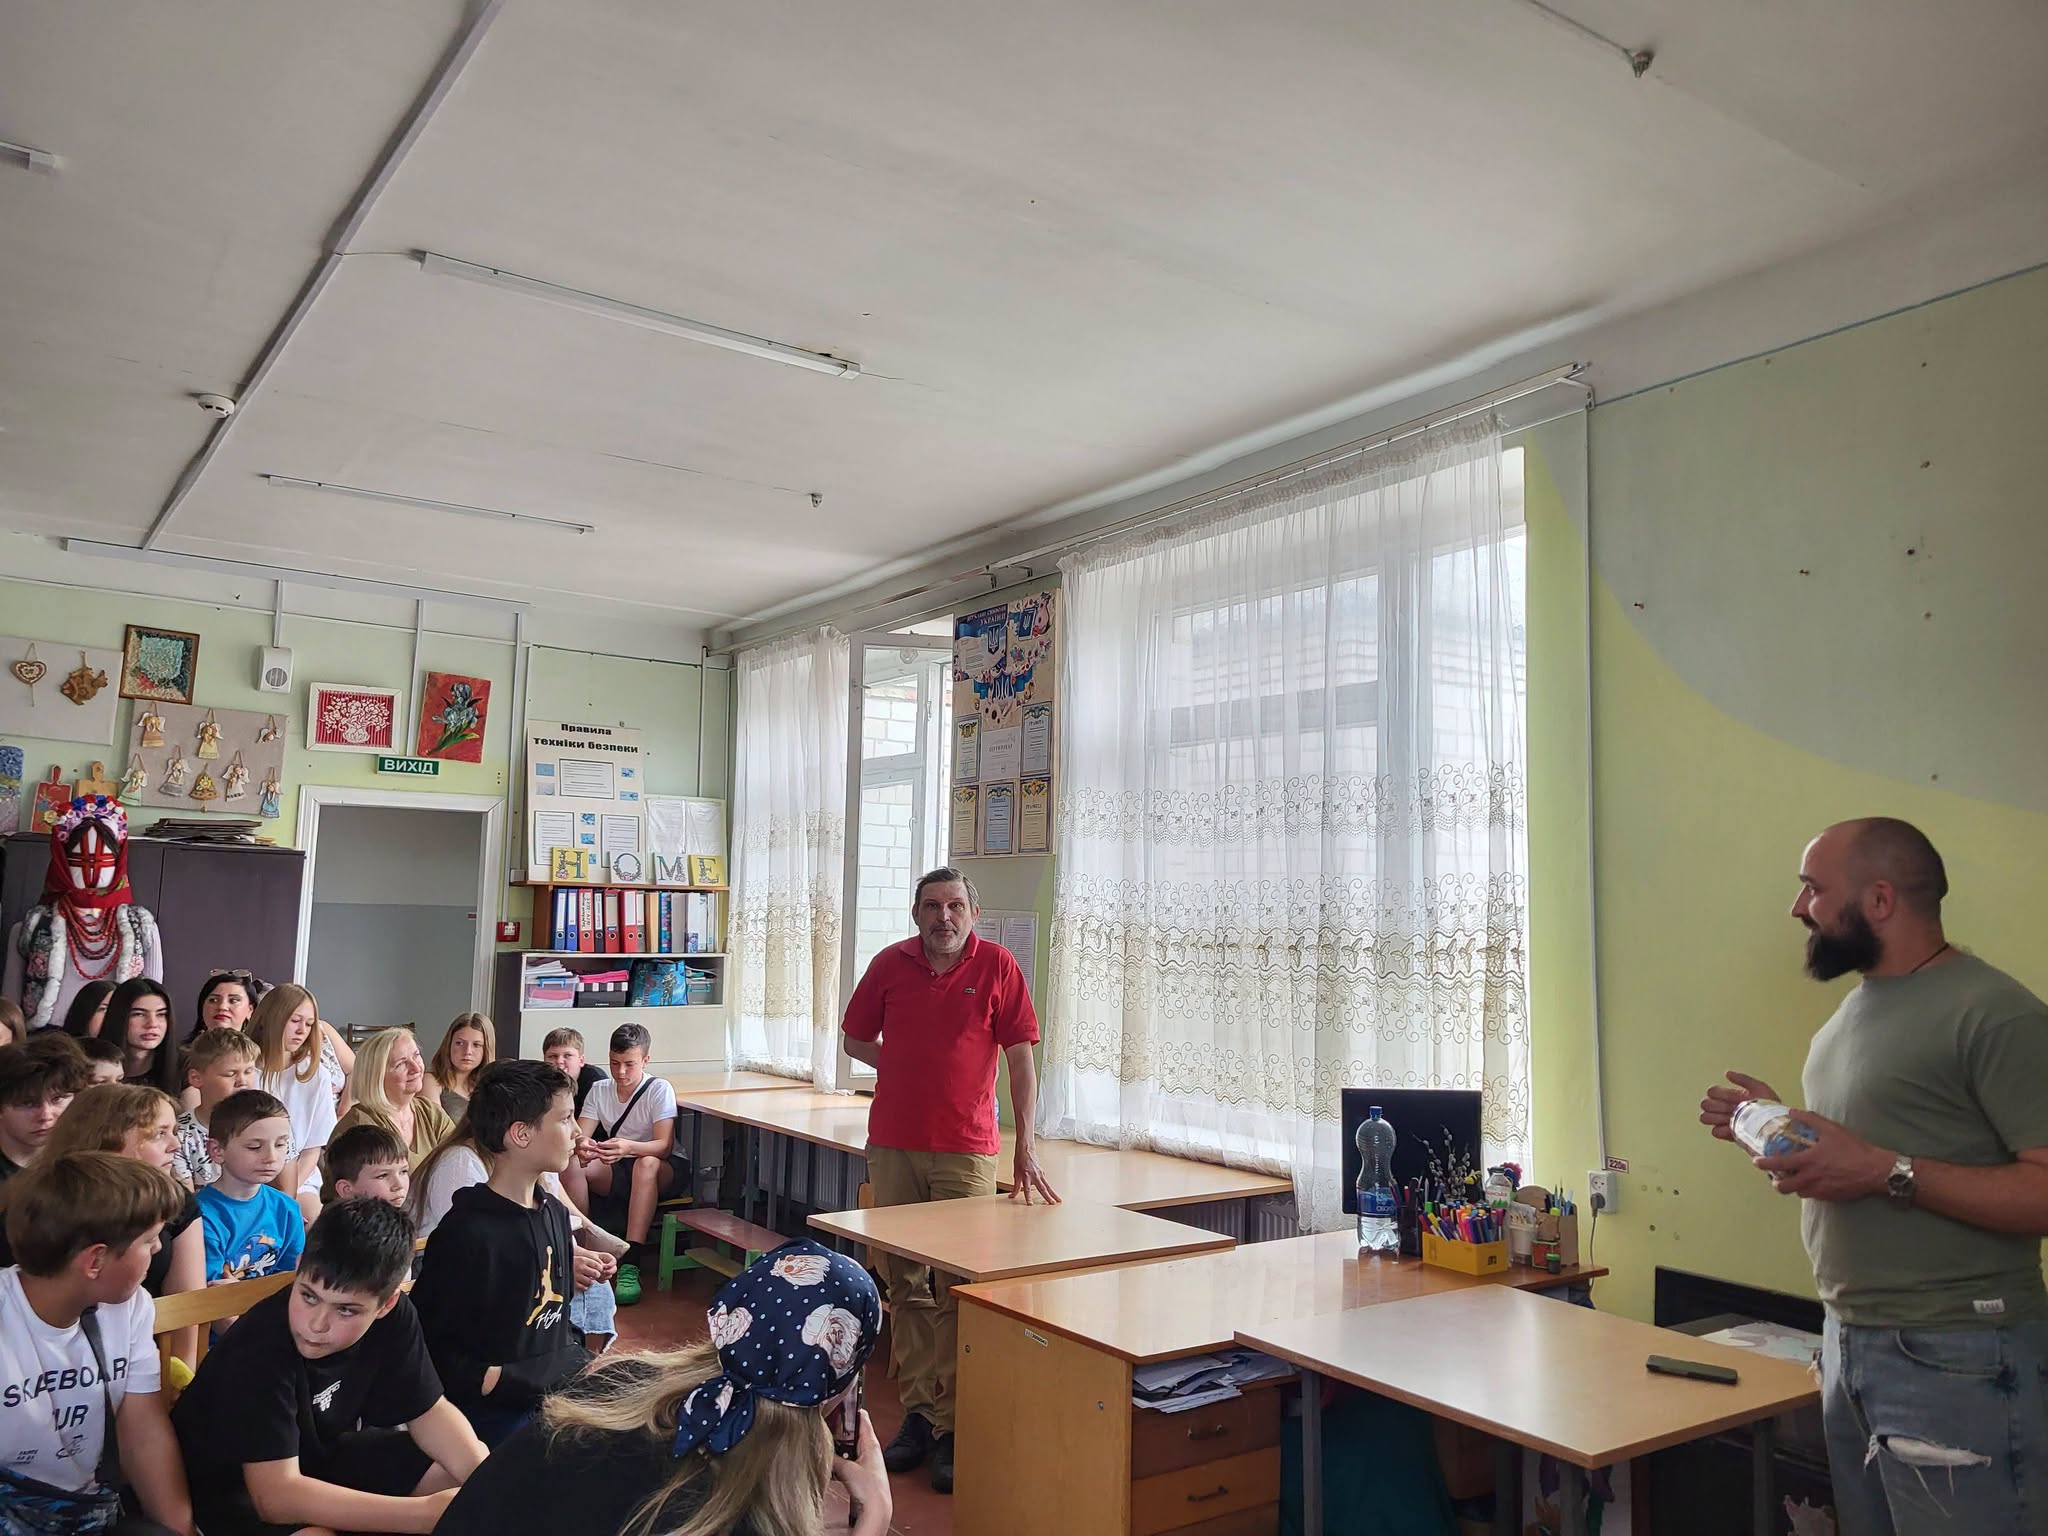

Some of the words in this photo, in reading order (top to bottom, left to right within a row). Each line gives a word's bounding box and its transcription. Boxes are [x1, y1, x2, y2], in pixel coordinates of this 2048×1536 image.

[561, 723, 612, 735] Правила
[533, 737, 585, 749] техніки
[588, 741, 638, 754] безпеки
[384, 759, 433, 774] ВИХІД
[535, 1304, 563, 1330] Fligh
